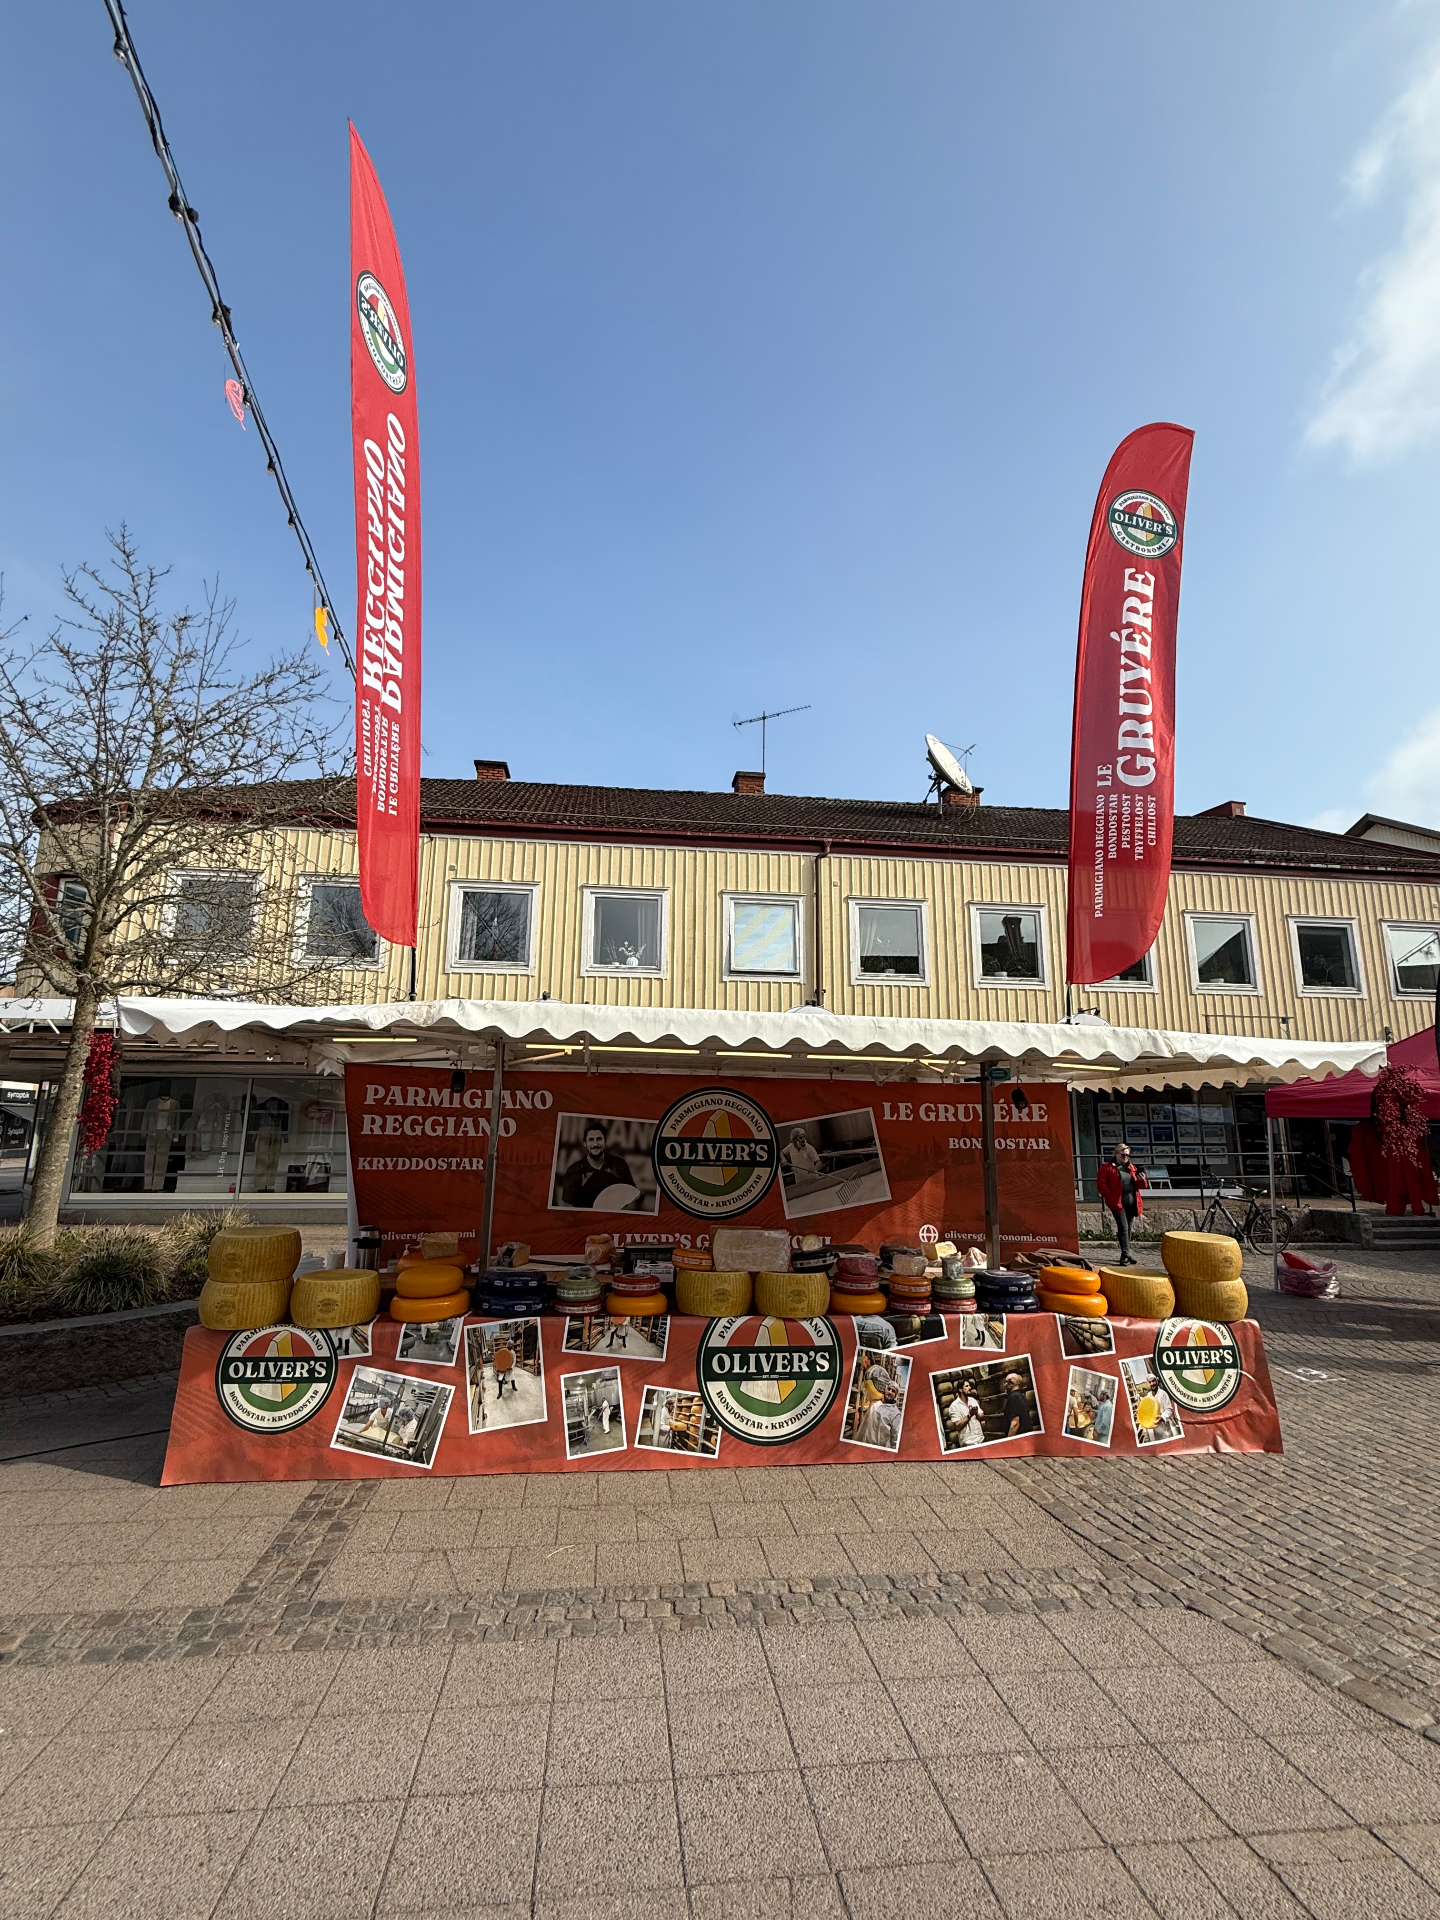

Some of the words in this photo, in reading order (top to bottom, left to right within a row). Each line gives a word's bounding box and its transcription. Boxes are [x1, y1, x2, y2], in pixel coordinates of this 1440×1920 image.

[1114, 512, 1173, 535] OLIVER'S
[1117, 531, 1167, 553] GASTRONOMI
[1109, 567, 1157, 787] GRUYÉRE
[1097, 763, 1113, 787] LE
[1095, 794, 1105, 848] REGGIANO
[1108, 793, 1118, 859] BONDOSTAR
[1121, 793, 1131, 849] PESTOOST
[1134, 794, 1144, 861] TRYFFELOST
[1147, 795, 1157, 846] CHILIOST
[1094, 849, 1104, 918] PARMIGIANO
[364, 1084, 554, 1110] PARMIGIANO
[670, 1098, 723, 1131] PARMIGIANO
[724, 1099, 764, 1133] REGGIANO
[882, 1102, 914, 1121] LE
[360, 1114, 517, 1138] REGGIANO
[664, 1142, 769, 1162] OLIVER'S
[948, 1137, 1051, 1150] BONOSTAR
[357, 1157, 484, 1171] KRYDDOSTAR
[668, 1172, 710, 1208] BONDOSTAR
[715, 1174, 763, 1208] KRYDDOSTAR
[381, 1229, 476, 1242] oliversgomi
[944, 1230, 1058, 1243] oliversgronomi.com
[228, 1360, 327, 1379] OLIVER'S
[711, 1350, 830, 1374] OLIVER'S
[1162, 1349, 1233, 1366] OLIVER'S
[1168, 1376, 1198, 1402] BONDOSTAR
[229, 1390, 266, 1422] BONDOSTAR
[271, 1389, 320, 1423] KRYDDOSTAR
[716, 1390, 763, 1430] BONDOSTAR
[770, 1387, 825, 1430] KRYDDOSTAR
